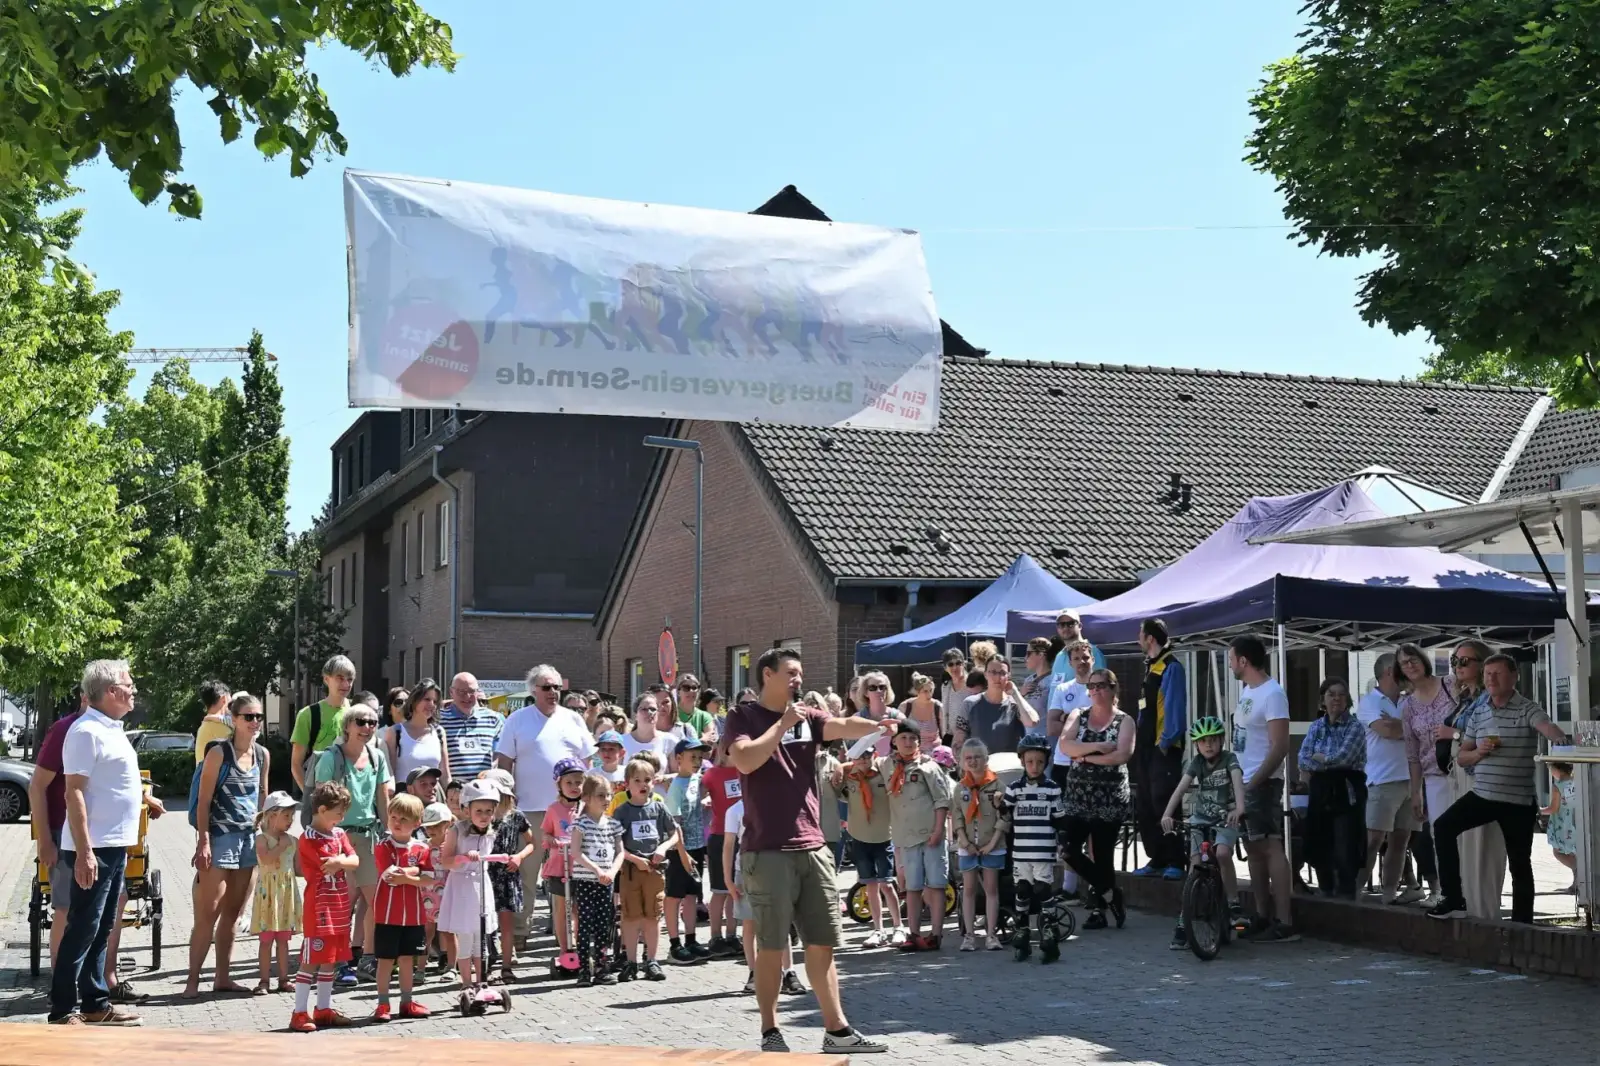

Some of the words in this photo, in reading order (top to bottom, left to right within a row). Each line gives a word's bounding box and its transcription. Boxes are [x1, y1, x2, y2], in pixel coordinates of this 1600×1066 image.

[464, 741, 475, 749] 63
[731, 783, 741, 792] 61
[638, 824, 651, 834] 40
[596, 848, 608, 858] 48
